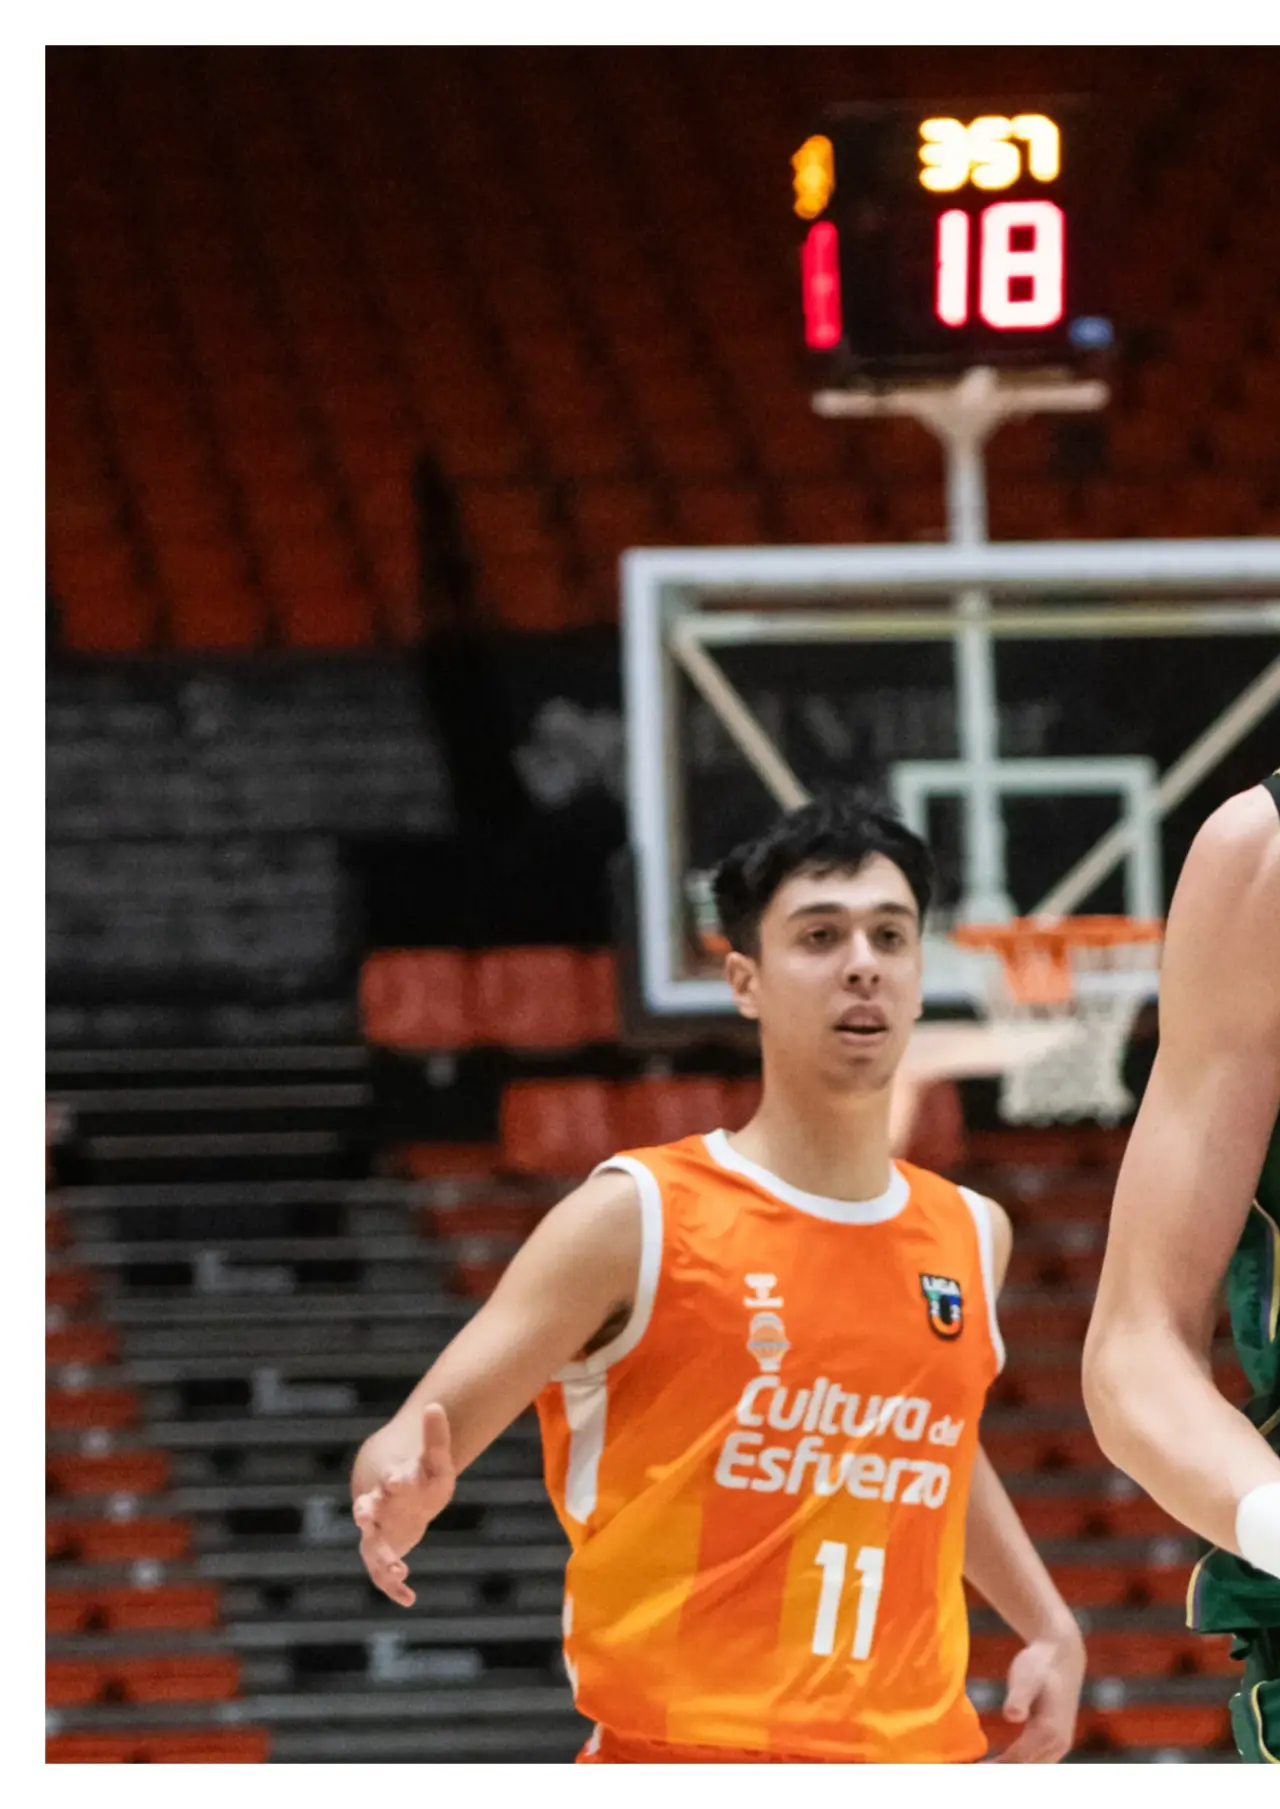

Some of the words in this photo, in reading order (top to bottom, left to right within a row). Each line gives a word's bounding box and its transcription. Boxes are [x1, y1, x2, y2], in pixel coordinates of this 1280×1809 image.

[936, 200, 1064, 330] 18
[921, 1274, 961, 1296] LIGA
[735, 1375, 931, 1441] Cultura
[928, 1415, 965, 1447] del
[714, 1431, 951, 1510] Esfuerzo
[811, 1539, 886, 1661] 11
